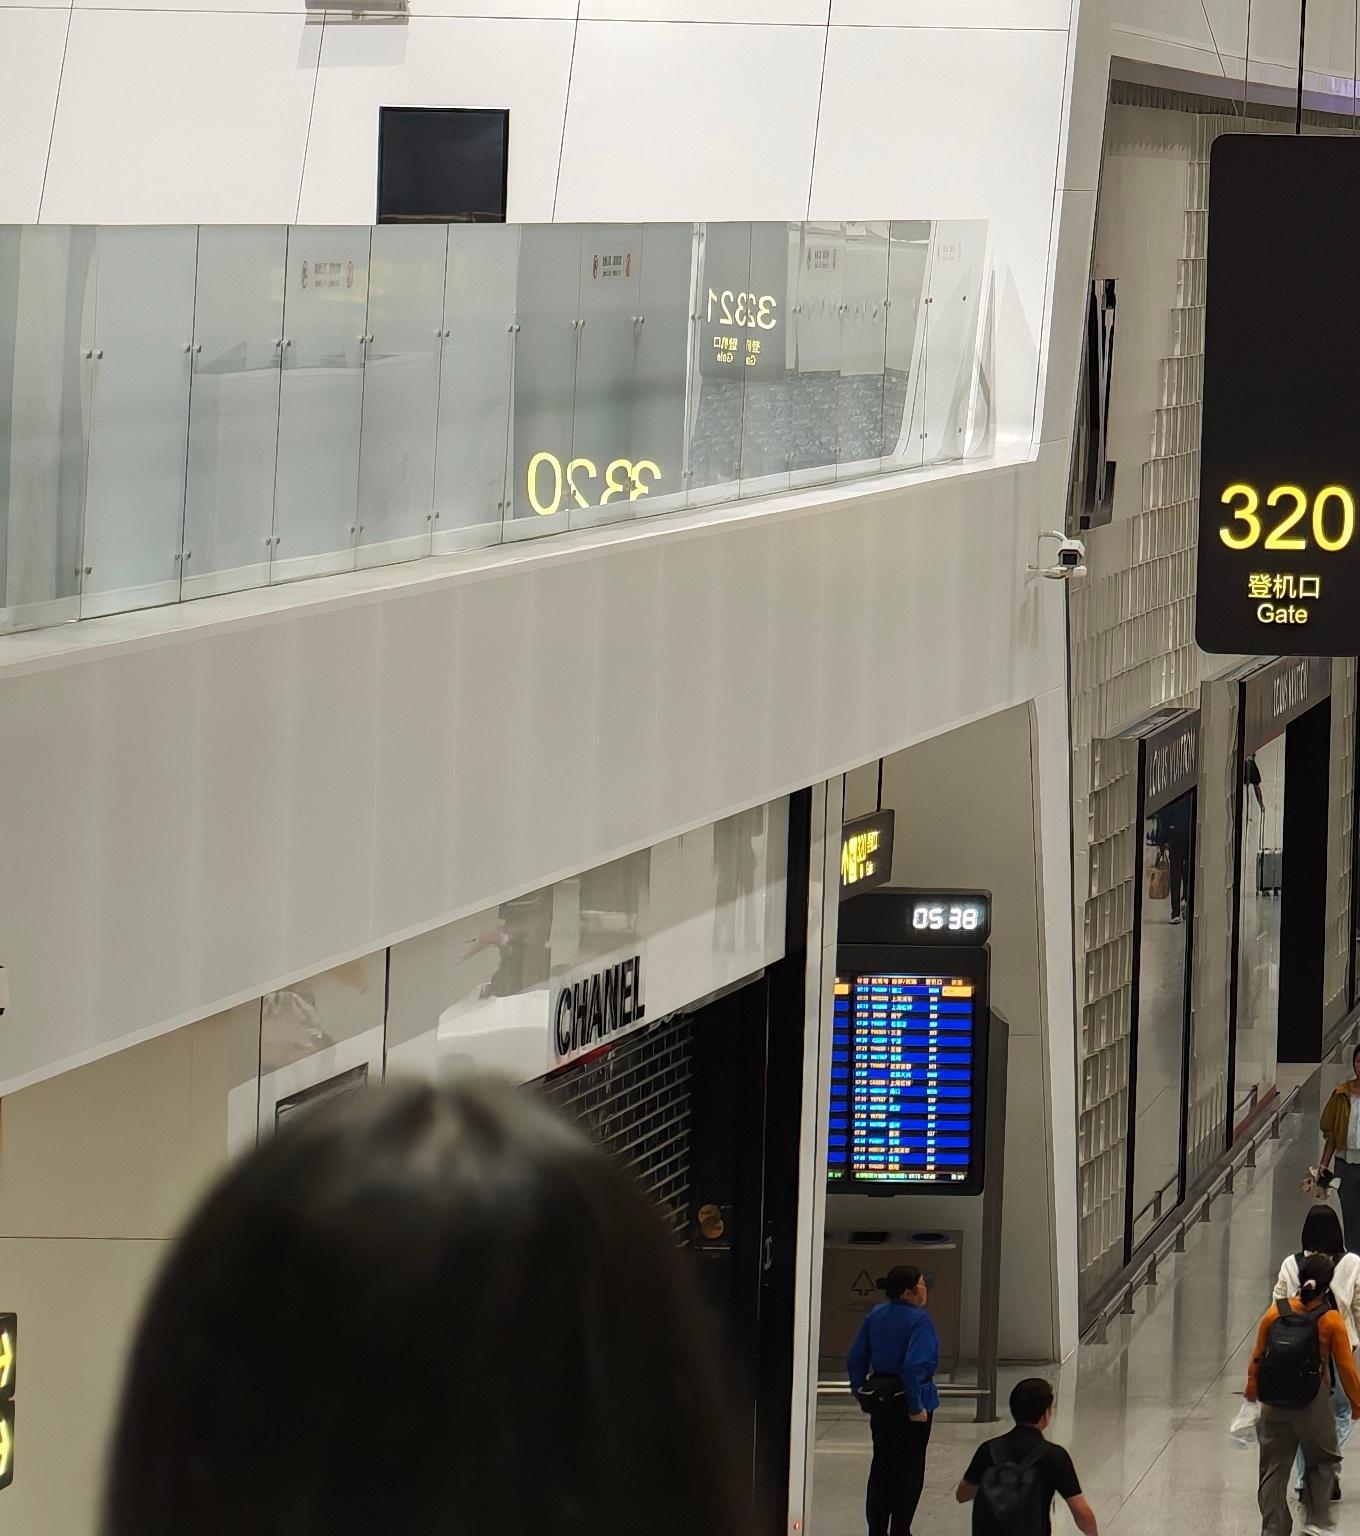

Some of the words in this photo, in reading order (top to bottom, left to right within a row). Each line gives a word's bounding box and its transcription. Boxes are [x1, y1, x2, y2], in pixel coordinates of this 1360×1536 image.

[1218, 483, 1356, 552] 320
[1247, 573, 1321, 600] 登机口
[1256, 603, 1309, 625] Gate
[554, 956, 646, 1056] CHANEL
